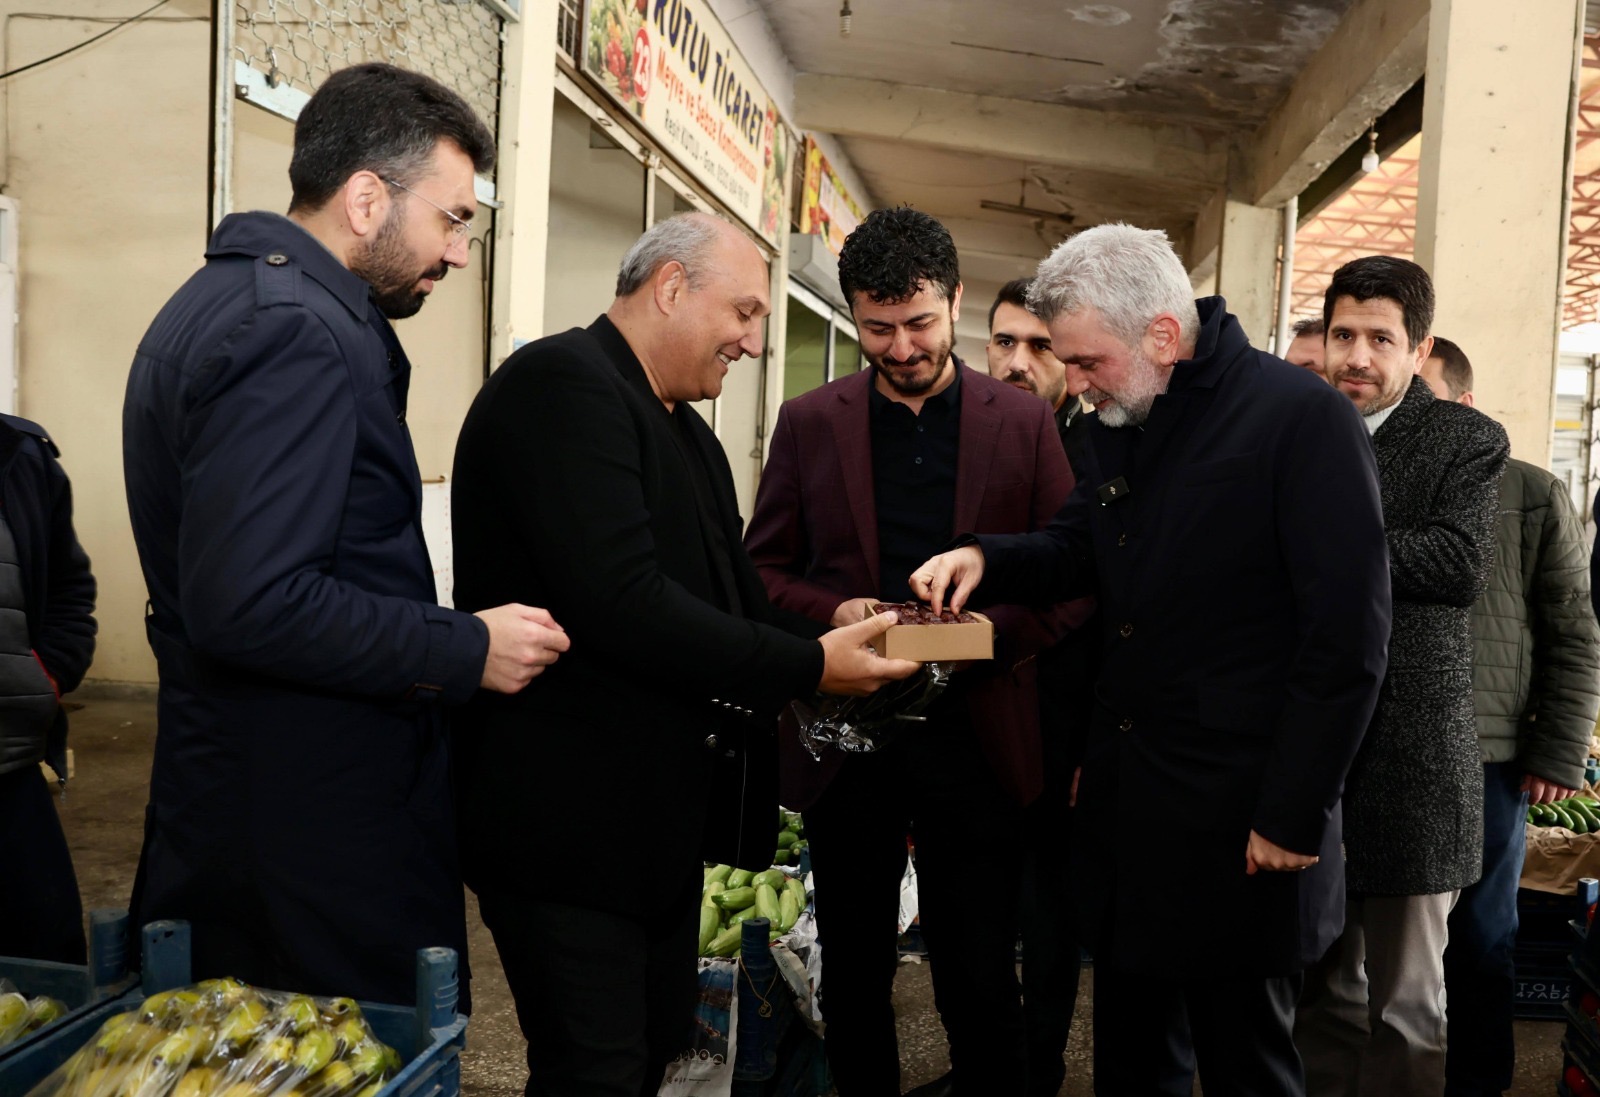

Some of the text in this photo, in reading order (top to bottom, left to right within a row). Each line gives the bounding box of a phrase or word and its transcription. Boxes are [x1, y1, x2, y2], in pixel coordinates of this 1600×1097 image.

[634, 36, 650, 93] 23
[656, 46, 683, 104] Meyve
[686, 88, 695, 117] ve
[696, 94, 717, 141] Sebze
[713, 48, 764, 151] TİCARET
